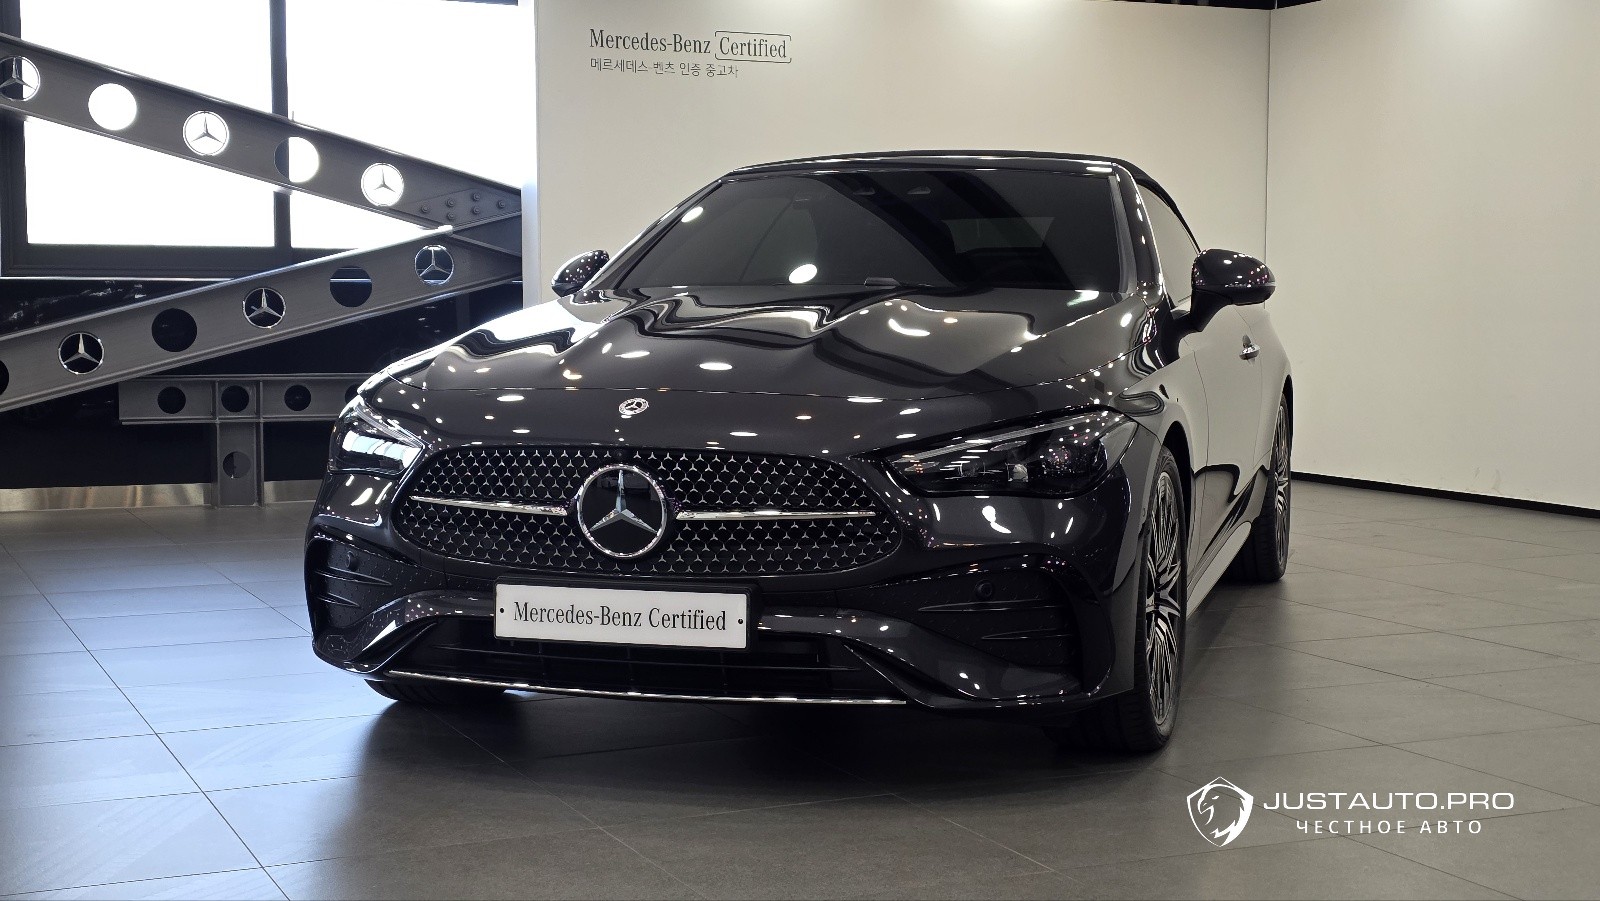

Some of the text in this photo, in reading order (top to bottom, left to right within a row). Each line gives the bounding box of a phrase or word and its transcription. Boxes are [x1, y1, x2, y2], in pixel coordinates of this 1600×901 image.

[590, 28, 787, 58] Mercedes-Benz Certified
[590, 58, 738, 78] 메르세데스 벤츠 인증 중고차
[514, 602, 726, 631] Mercedes-Benz Certified
